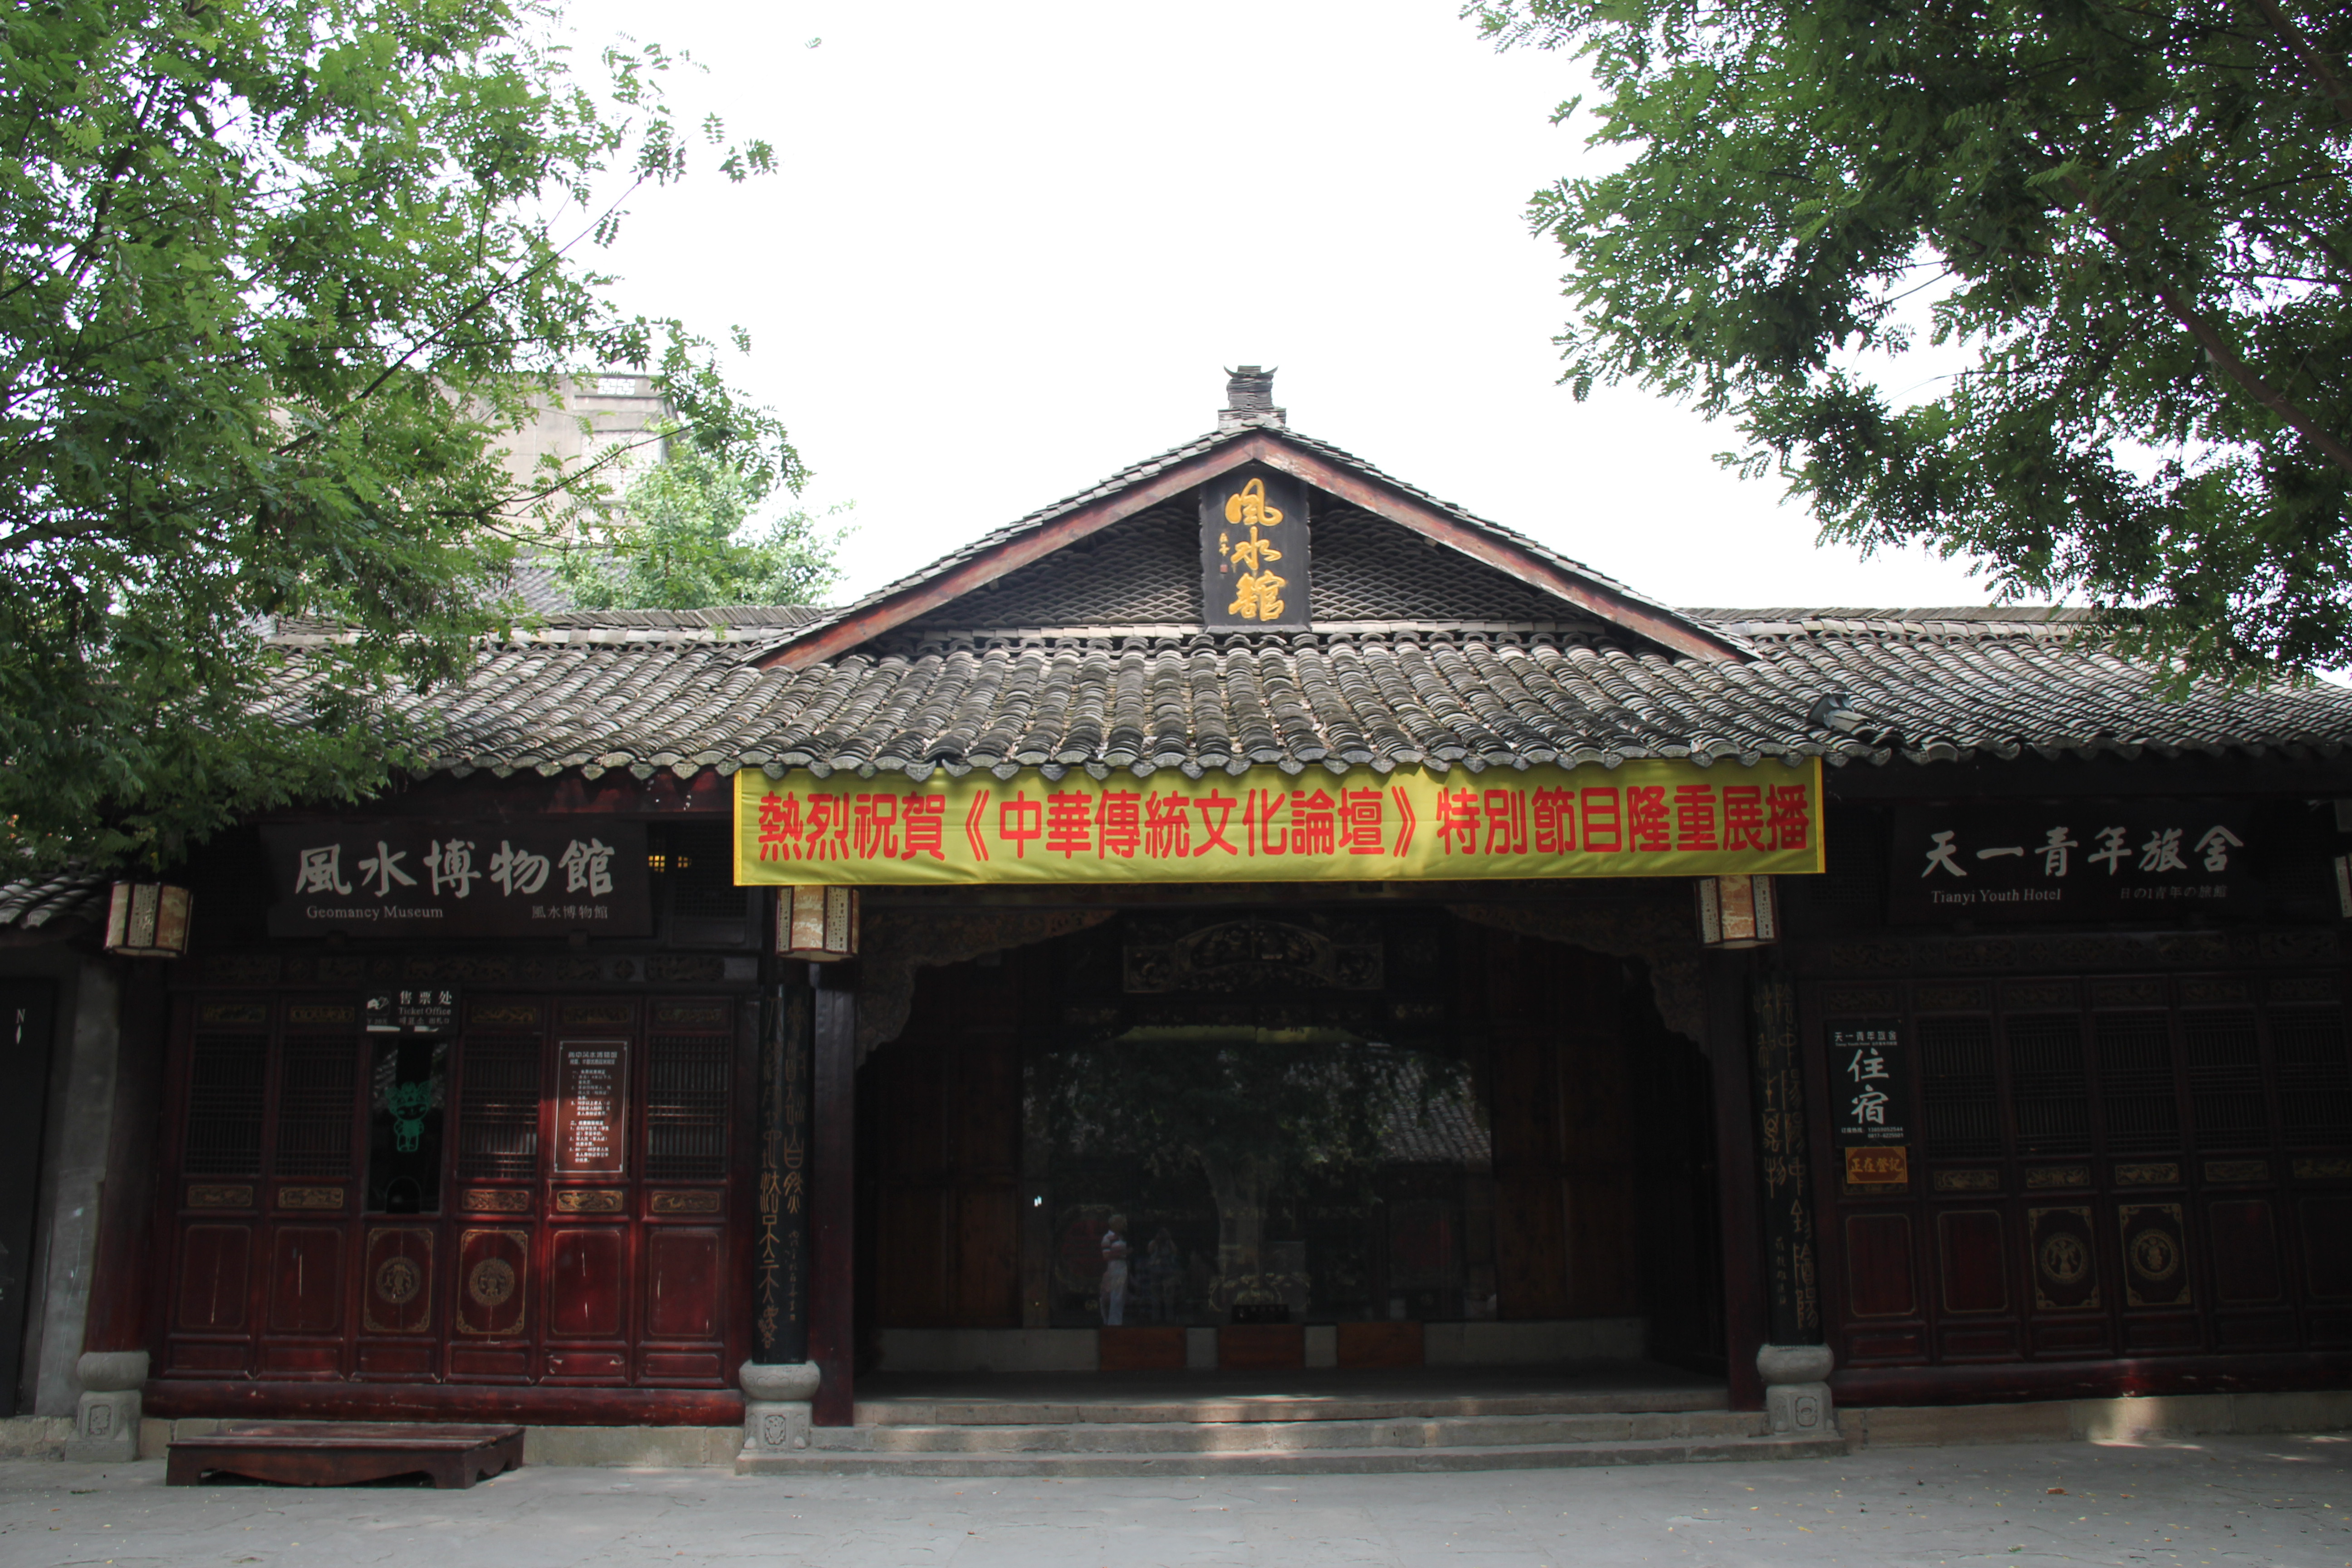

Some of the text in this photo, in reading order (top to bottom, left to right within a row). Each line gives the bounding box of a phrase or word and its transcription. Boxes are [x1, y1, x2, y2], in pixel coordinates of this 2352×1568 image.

[1921, 825, 2244, 878] 天一青年旅舍
[295, 838, 616, 898] 風水博物館
[1931, 887, 2061, 906] Tianyi Youth Hotel
[306, 906, 443, 921] Geomancy Museum
[532, 905, 608, 920] 風水博物館
[400, 990, 452, 1005] 售票处
[398, 1006, 451, 1015] Ticket Office
[1847, 1047, 1890, 1125] 住宿
